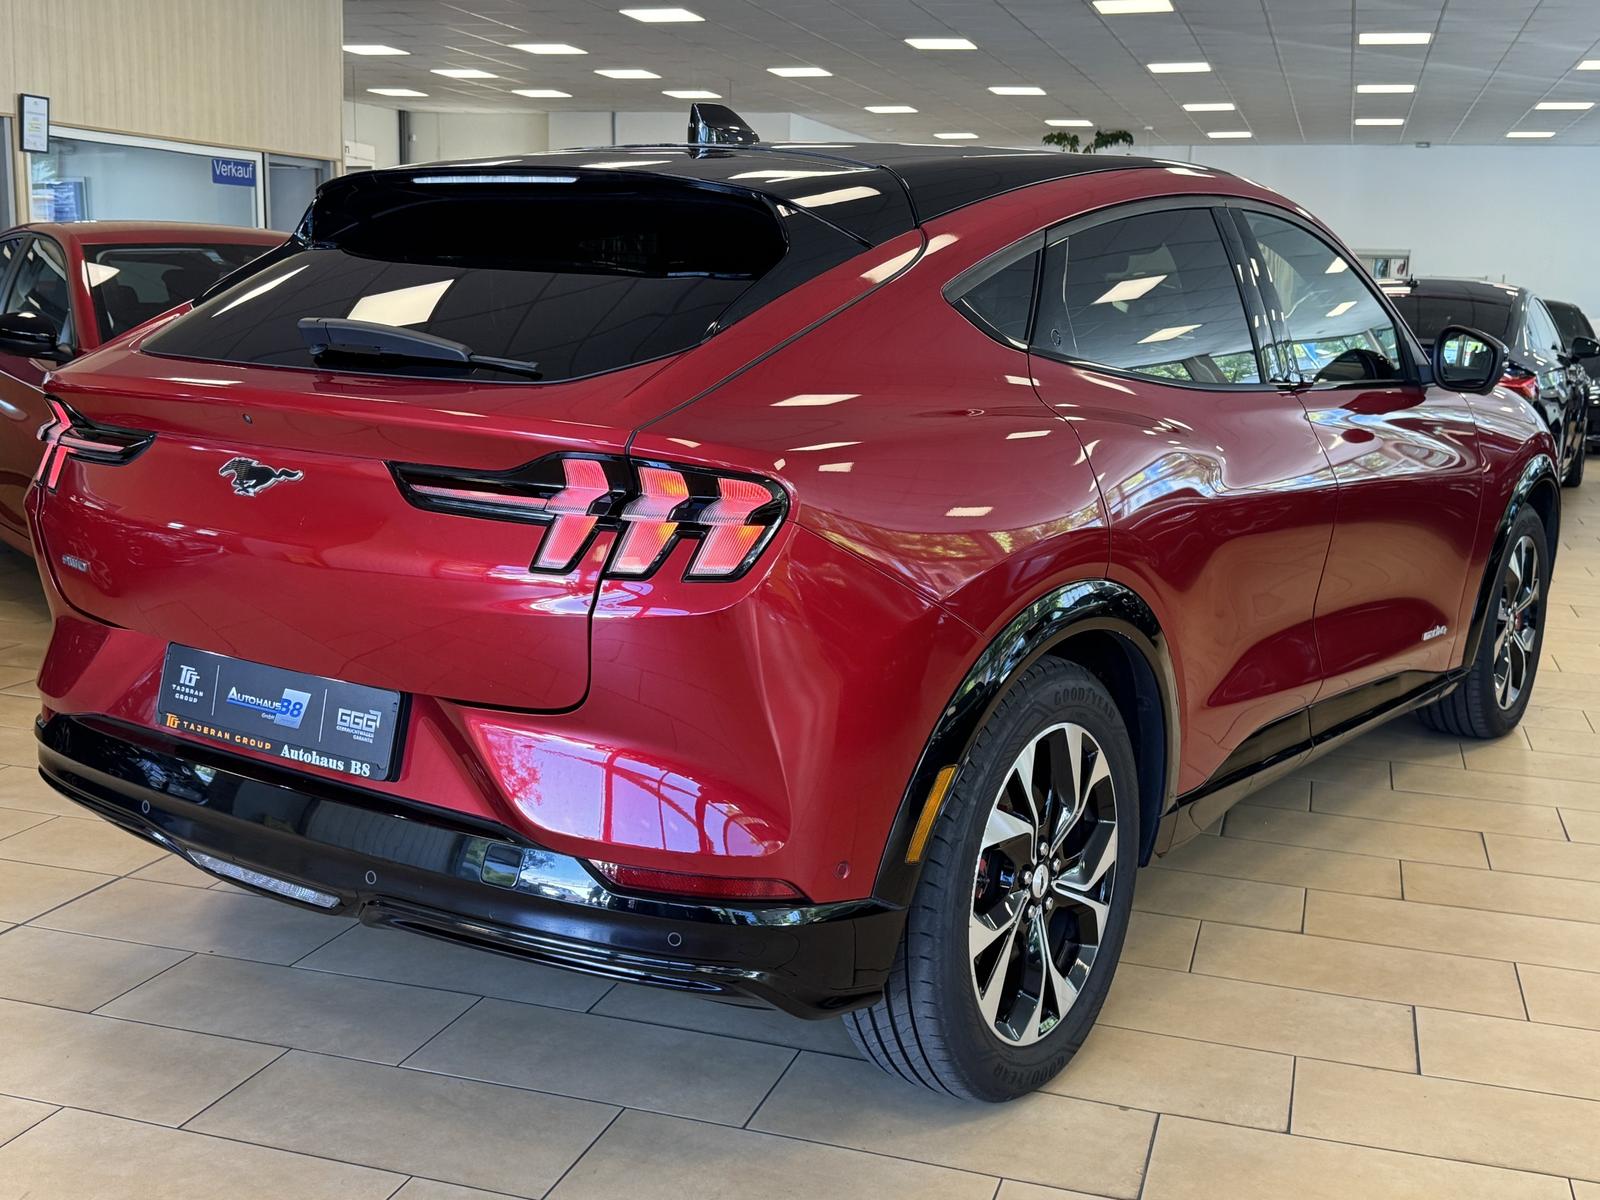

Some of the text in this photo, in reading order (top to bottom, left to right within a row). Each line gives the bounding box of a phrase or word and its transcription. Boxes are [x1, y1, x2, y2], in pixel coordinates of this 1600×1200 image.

[214, 160, 253, 179] Verkauf
[172, 684, 203, 697] TAJERAN
[175, 693, 198, 703] GROUP
[336, 707, 379, 733] GGG
[183, 721, 230, 740] TAJERAN
[234, 735, 271, 749] GROUP
[281, 744, 371, 777] Autohaus B8
